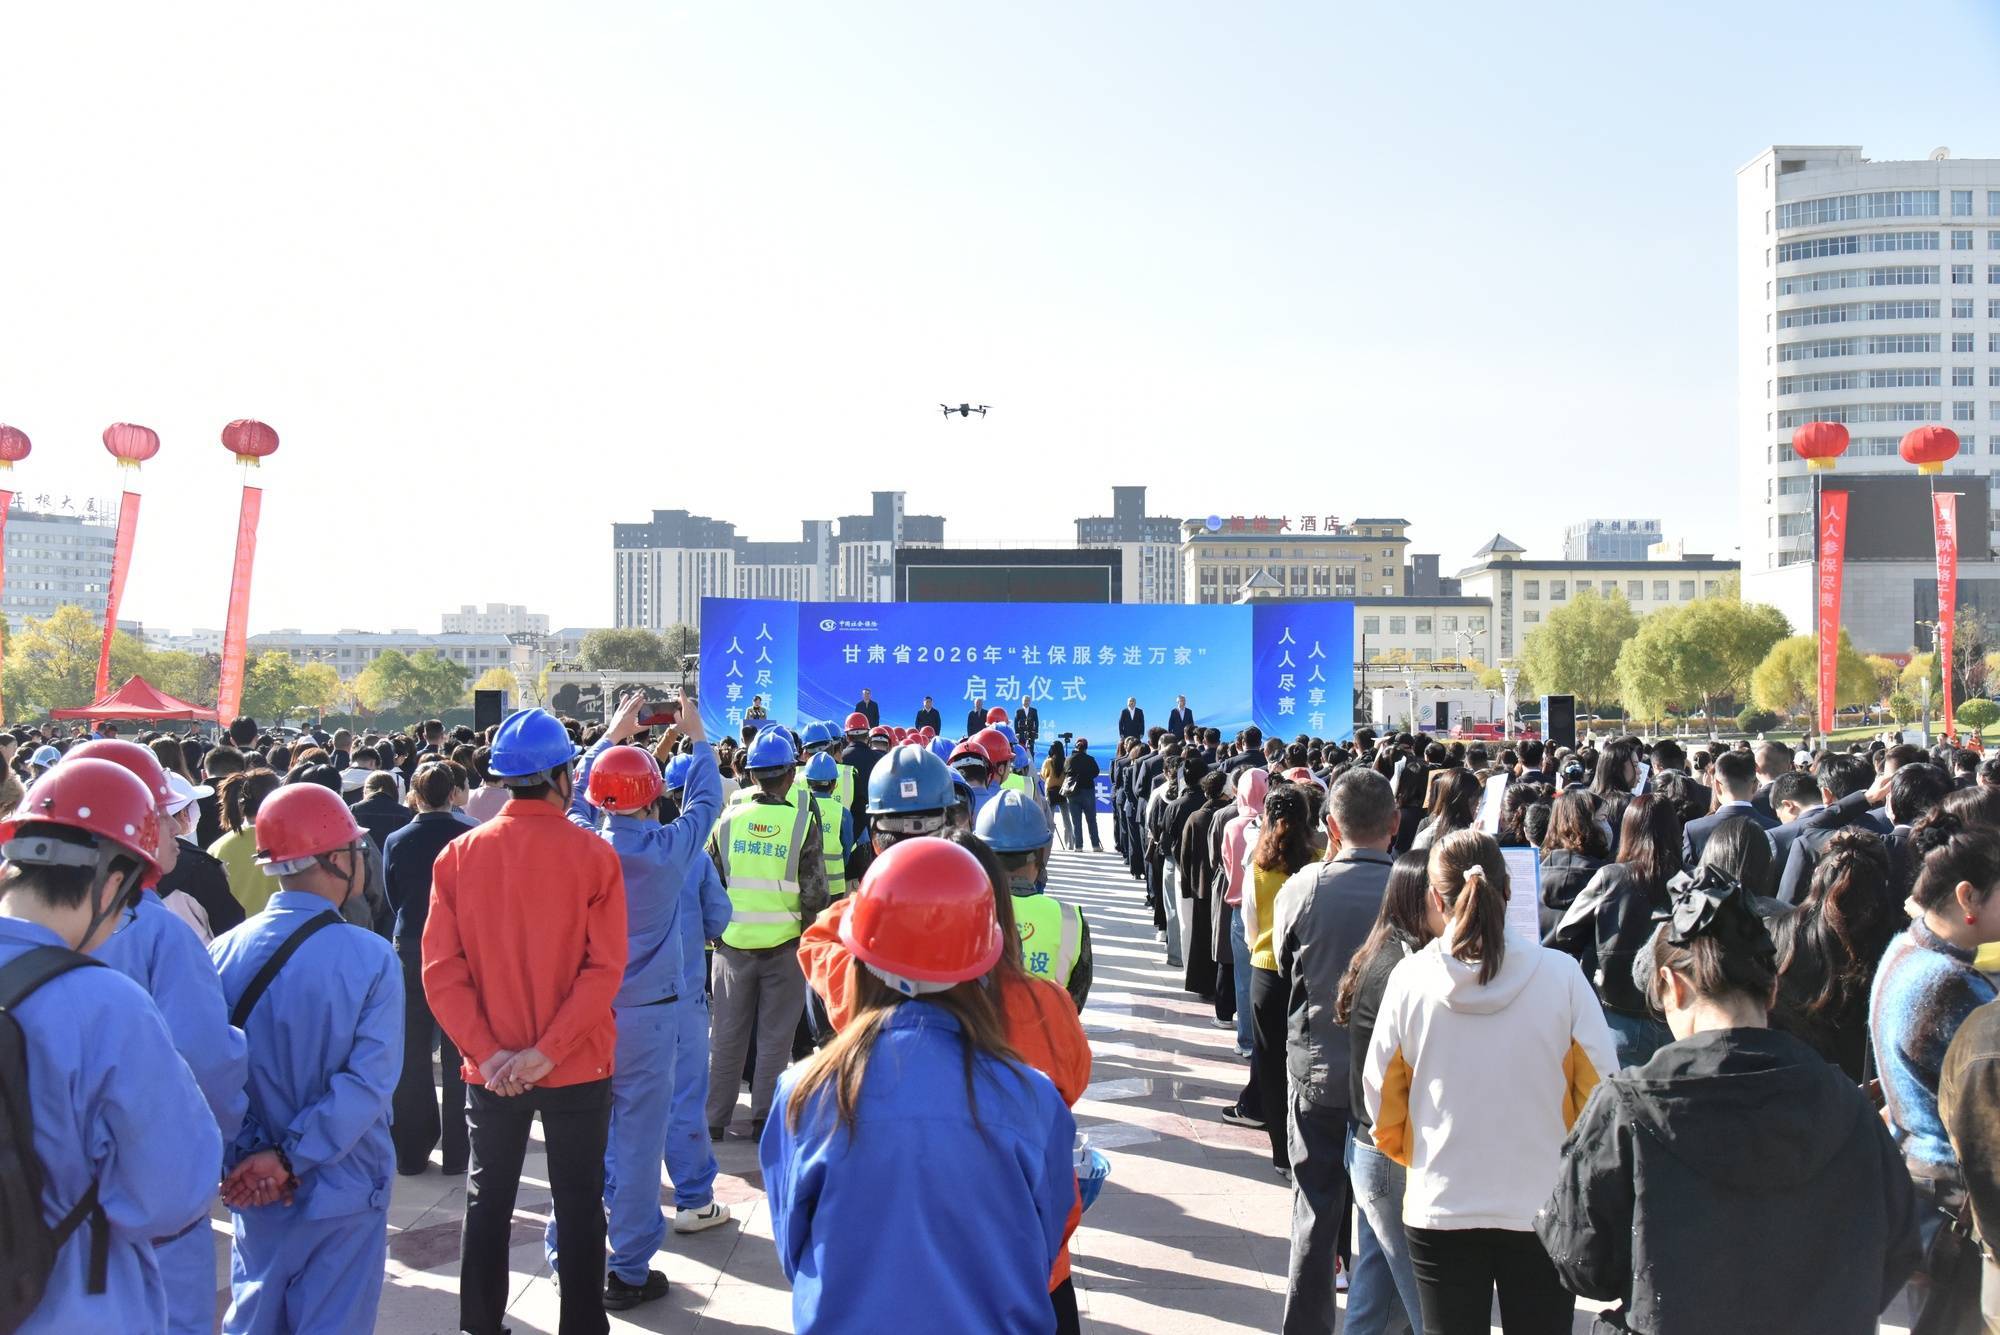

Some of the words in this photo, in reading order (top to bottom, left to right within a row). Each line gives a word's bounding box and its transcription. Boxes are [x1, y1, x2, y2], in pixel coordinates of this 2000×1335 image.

[842, 644, 1207, 665] 甘肃省2026年“社保服务进万家”
[726, 635, 744, 726] 人人享有
[1278, 627, 1296, 716] 人人尽责
[963, 675, 1087, 701] 启动仪式
[1308, 641, 1326, 730] 人人享有
[748, 822, 773, 833] BNMC
[733, 839, 787, 860] 铜城建设
